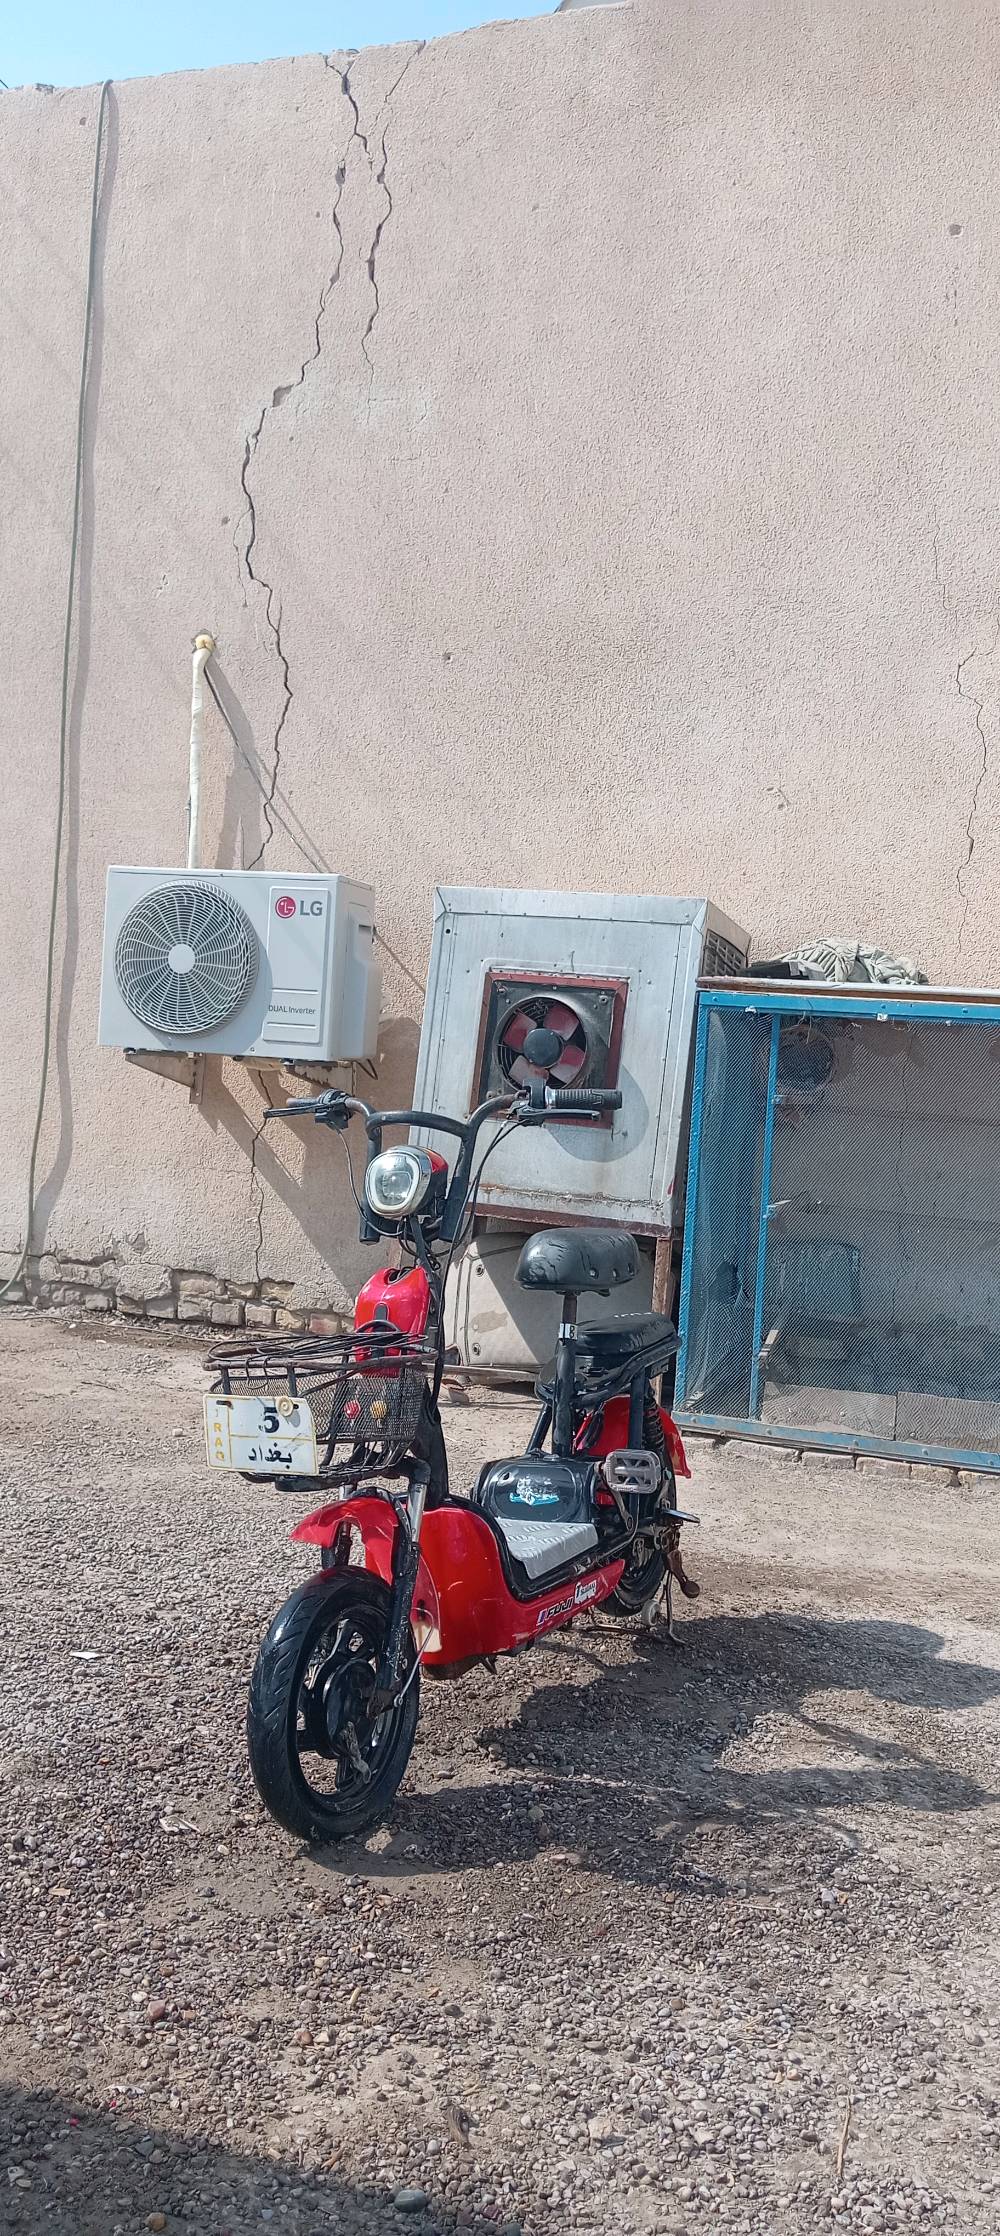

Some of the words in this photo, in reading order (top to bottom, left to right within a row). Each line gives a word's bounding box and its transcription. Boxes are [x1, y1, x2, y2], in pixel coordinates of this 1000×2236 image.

[300, 901, 323, 917] LG
[268, 1004, 287, 1013] DUAL
[288, 1005, 316, 1015] Inverter
[248, 1442, 293, 1470] بغداد
